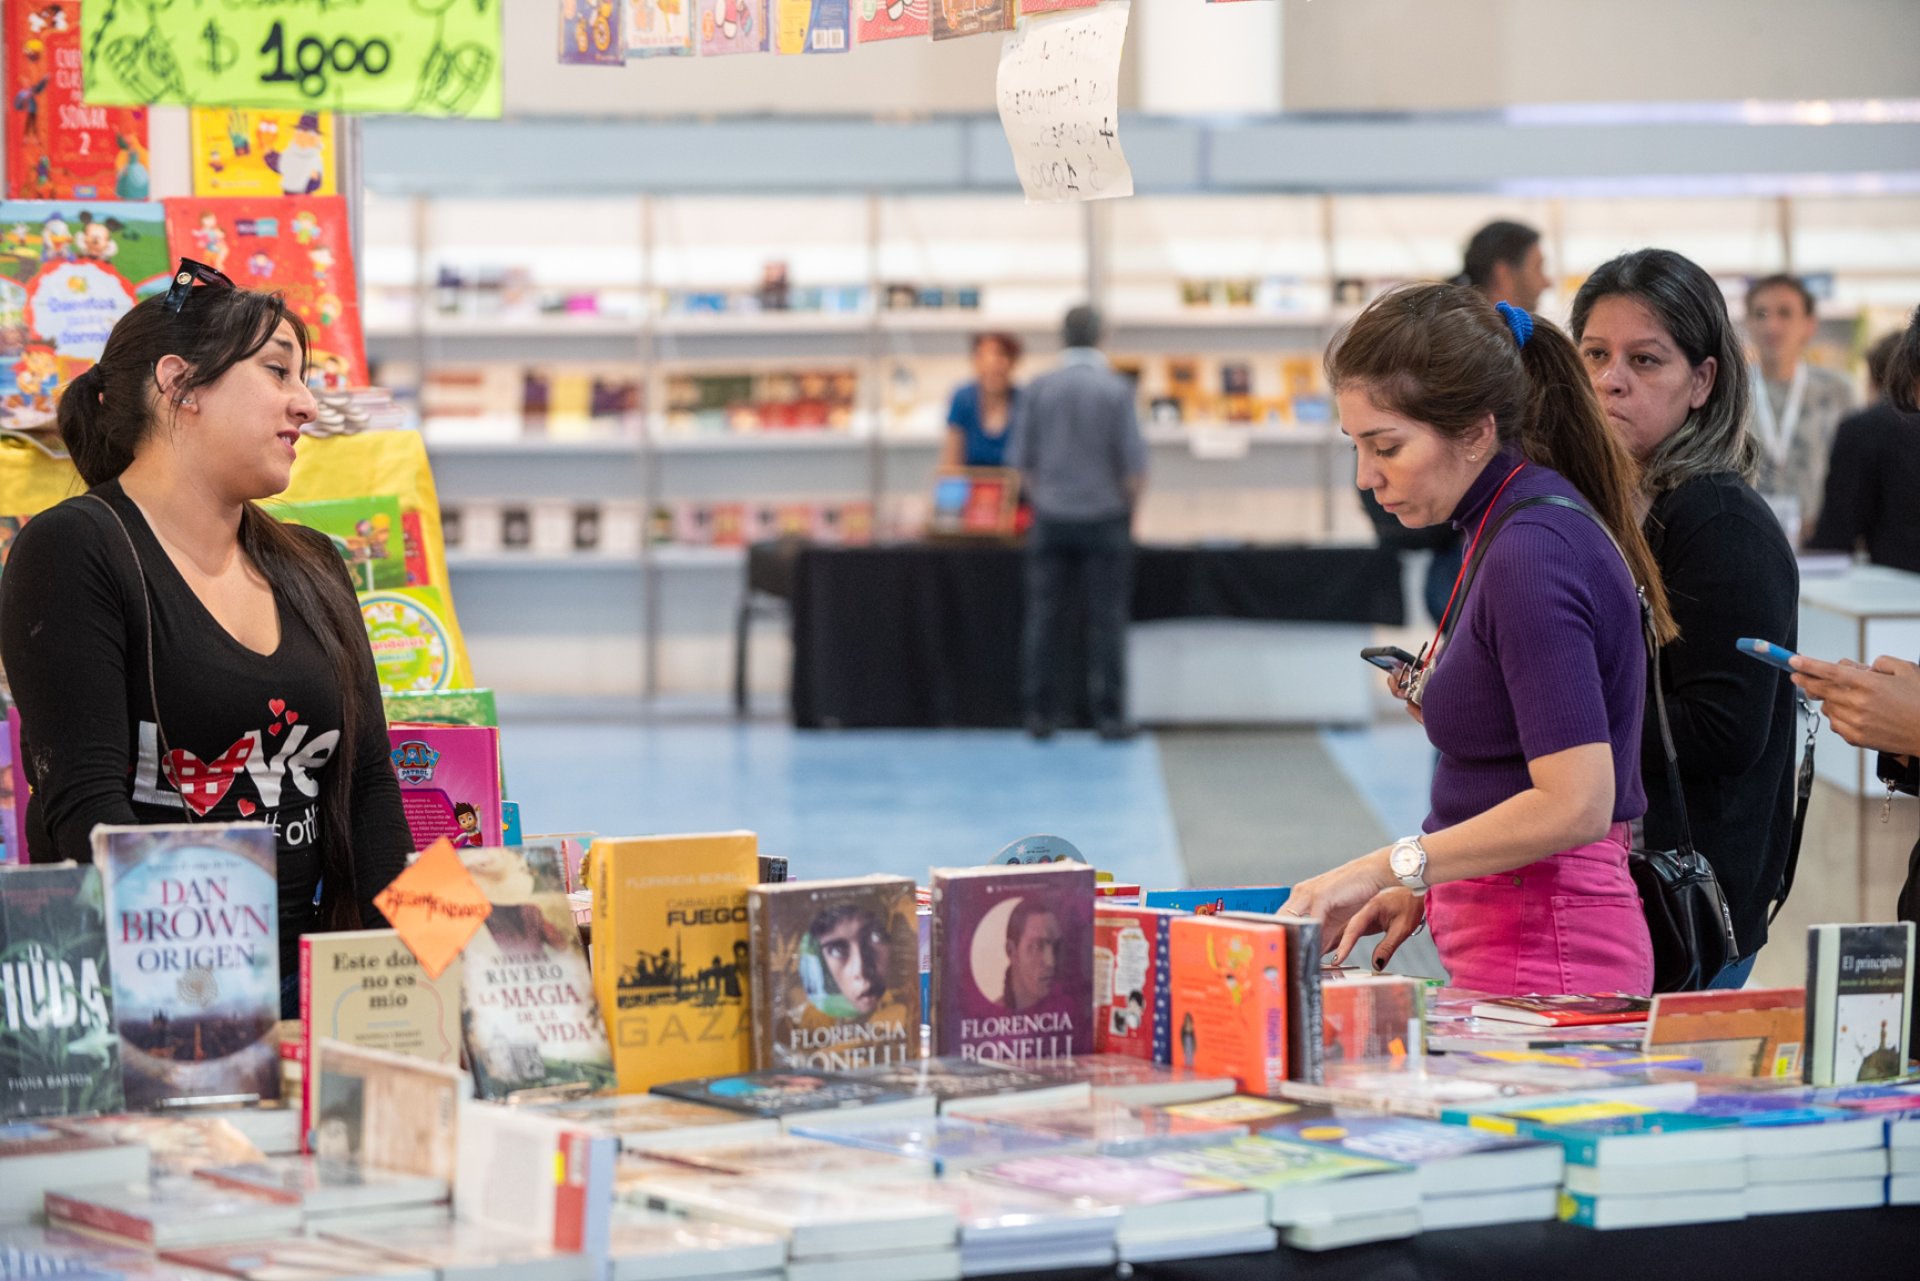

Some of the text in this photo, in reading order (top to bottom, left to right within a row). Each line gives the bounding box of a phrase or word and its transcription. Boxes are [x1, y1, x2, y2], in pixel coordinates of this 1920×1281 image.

[389, 747, 441, 769] PAW
[161, 875, 228, 906] DAN
[119, 903, 270, 944] BROWN
[667, 906, 749, 928] FUEGO
[137, 943, 256, 974] ORIGEN
[333, 951, 380, 972] Este
[1842, 953, 1903, 975] El principito
[361, 973, 416, 990] no es
[485, 964, 563, 985] RIVERO
[500, 982, 582, 1009] MAGIA
[535, 1021, 593, 1042] VIDA
[791, 1020, 907, 1050] FLORENCIA
[961, 1011, 1073, 1039] FLORENCIA
